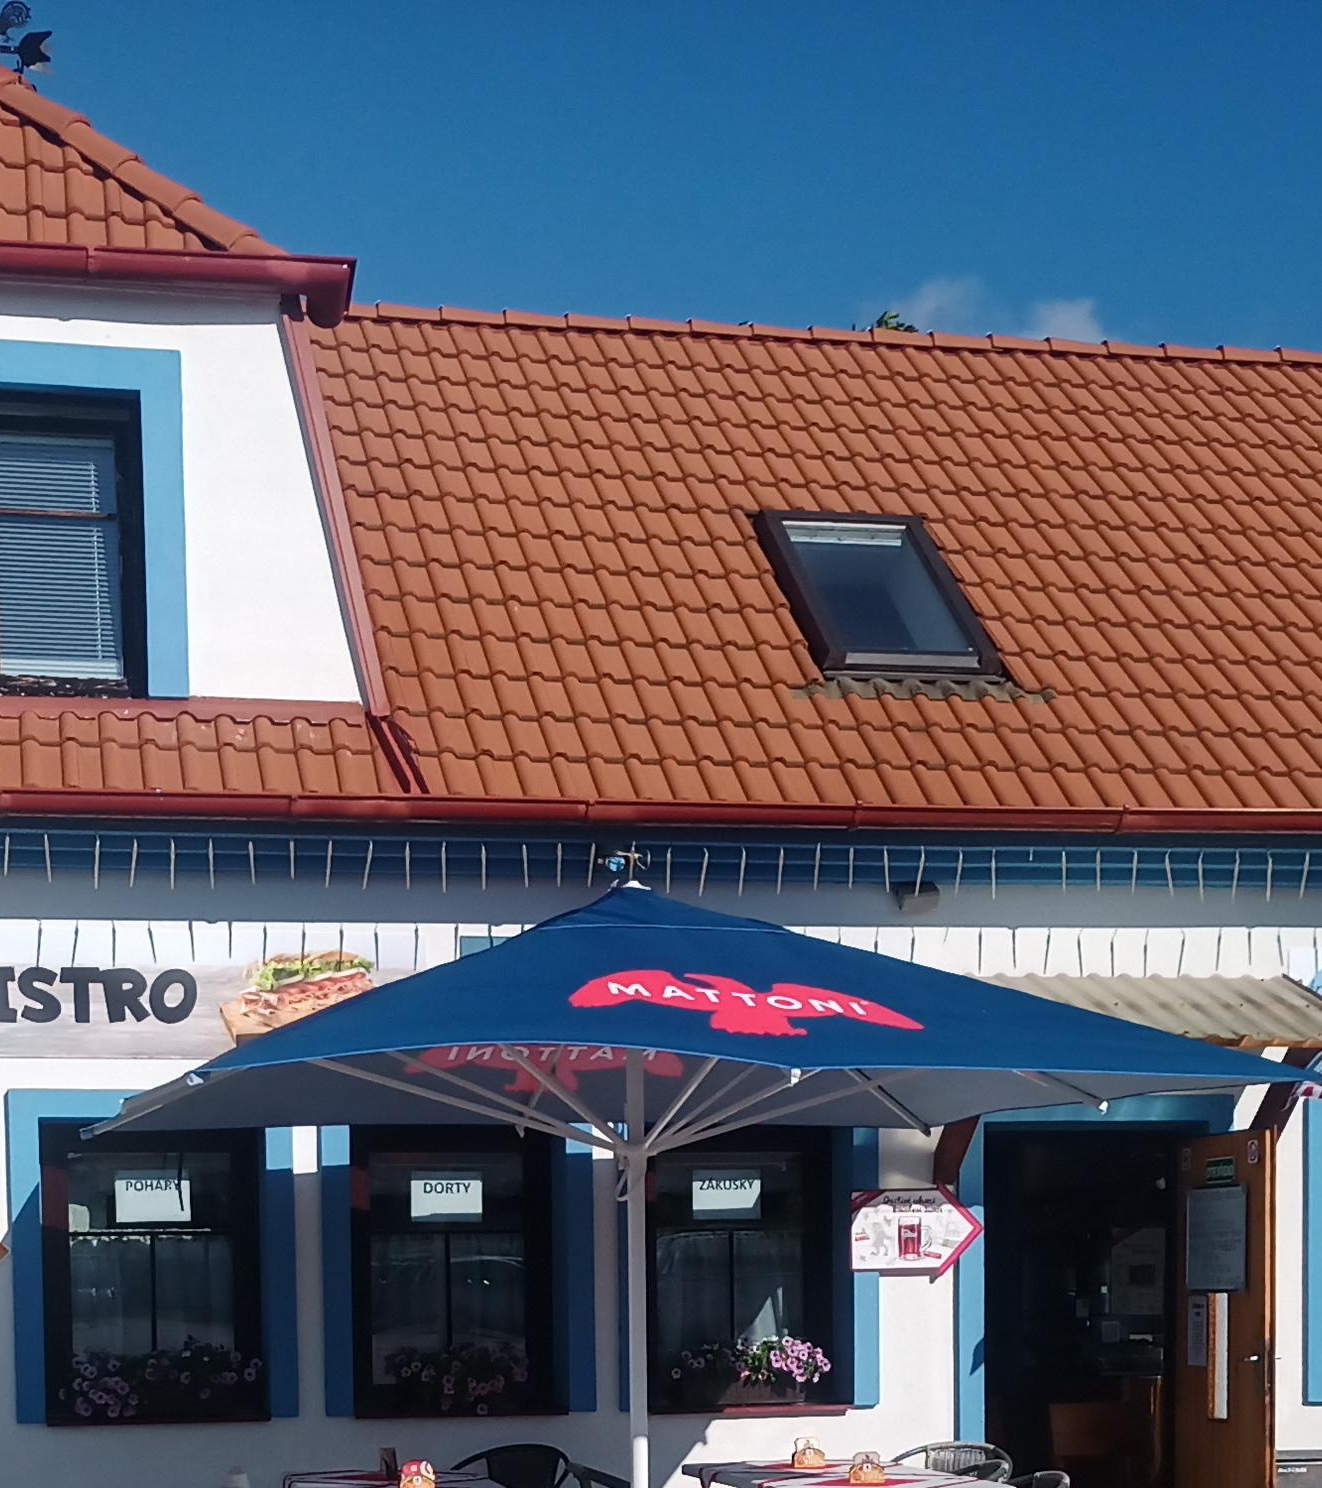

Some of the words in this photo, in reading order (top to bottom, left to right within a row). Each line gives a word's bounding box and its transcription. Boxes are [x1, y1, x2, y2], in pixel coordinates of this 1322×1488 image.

[607, 981, 867, 1016] MATTONI
[423, 1182, 471, 1194] DORTY
[699, 1178, 755, 1191] ZÁKUSKY
